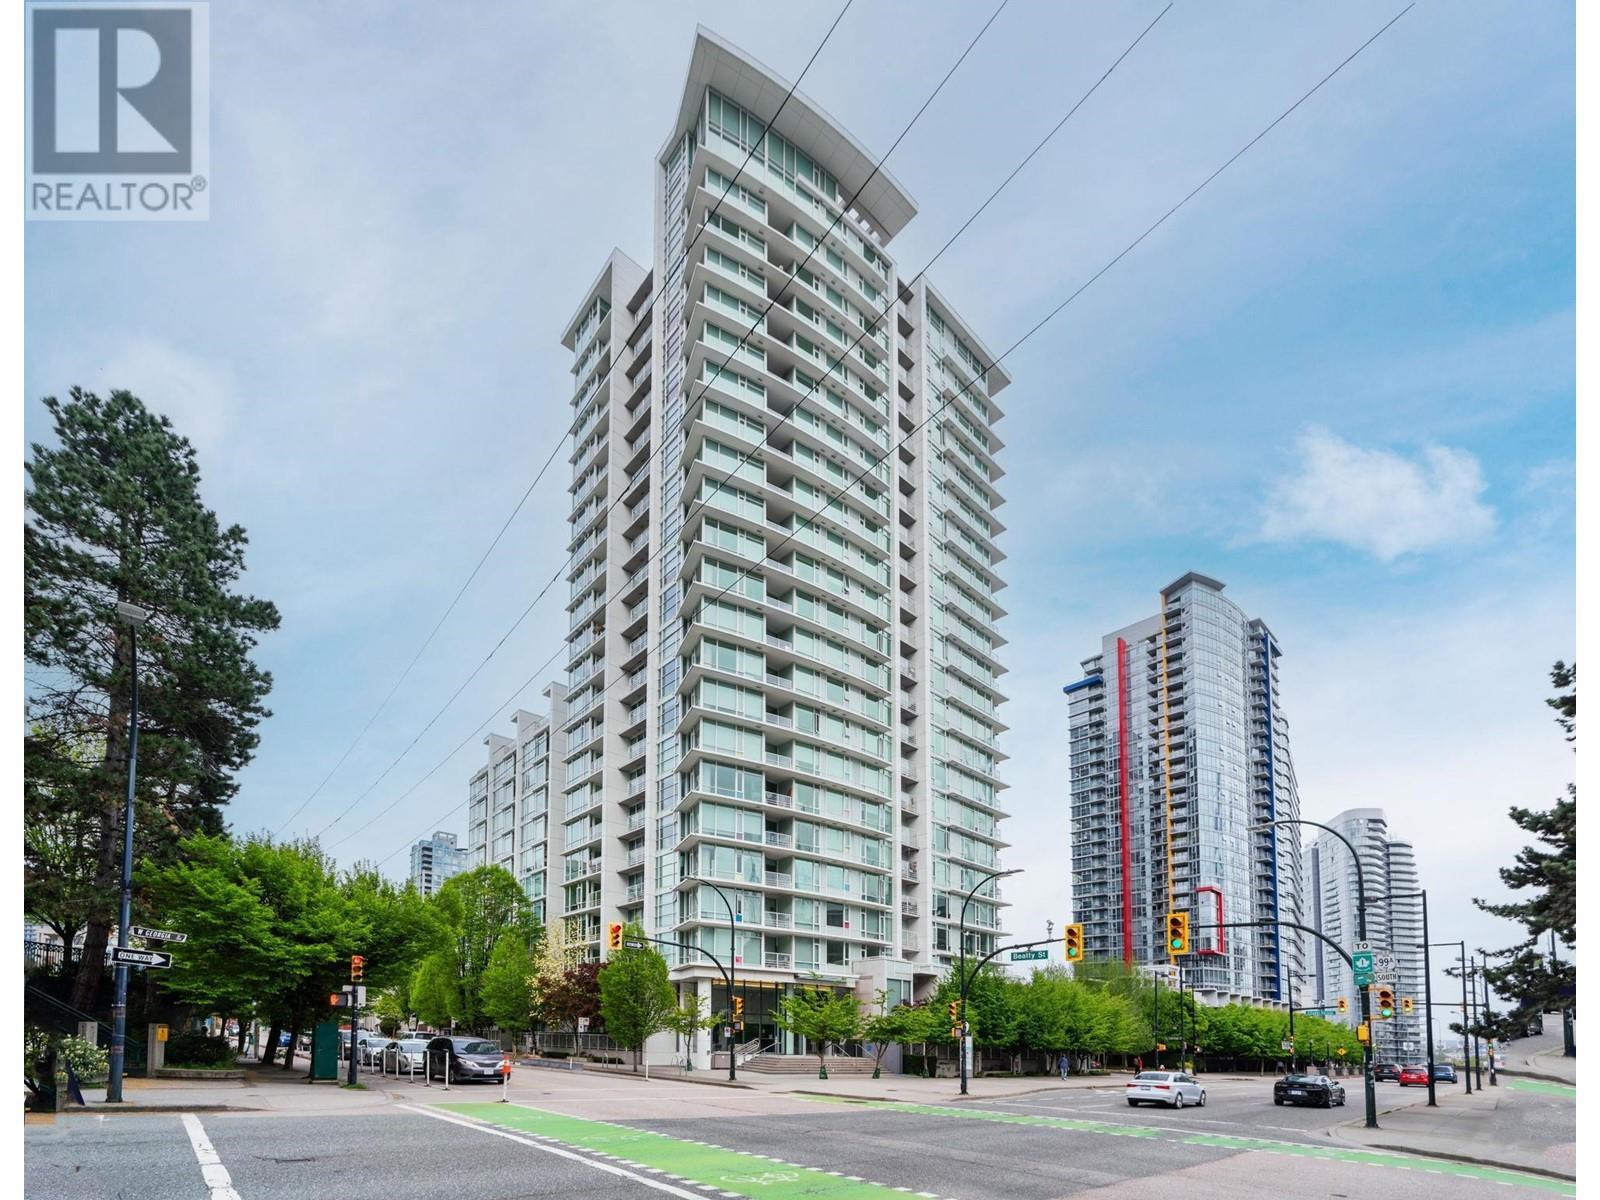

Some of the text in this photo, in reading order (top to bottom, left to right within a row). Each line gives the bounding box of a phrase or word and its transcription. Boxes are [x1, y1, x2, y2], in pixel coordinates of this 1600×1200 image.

[145, 929, 171, 939] GEORGIA
[1355, 942, 1369, 950] TO
[119, 951, 153, 962] ONE WAY
[1013, 952, 1035, 960] Beatty
[1377, 973, 1397, 981] SOUTH
